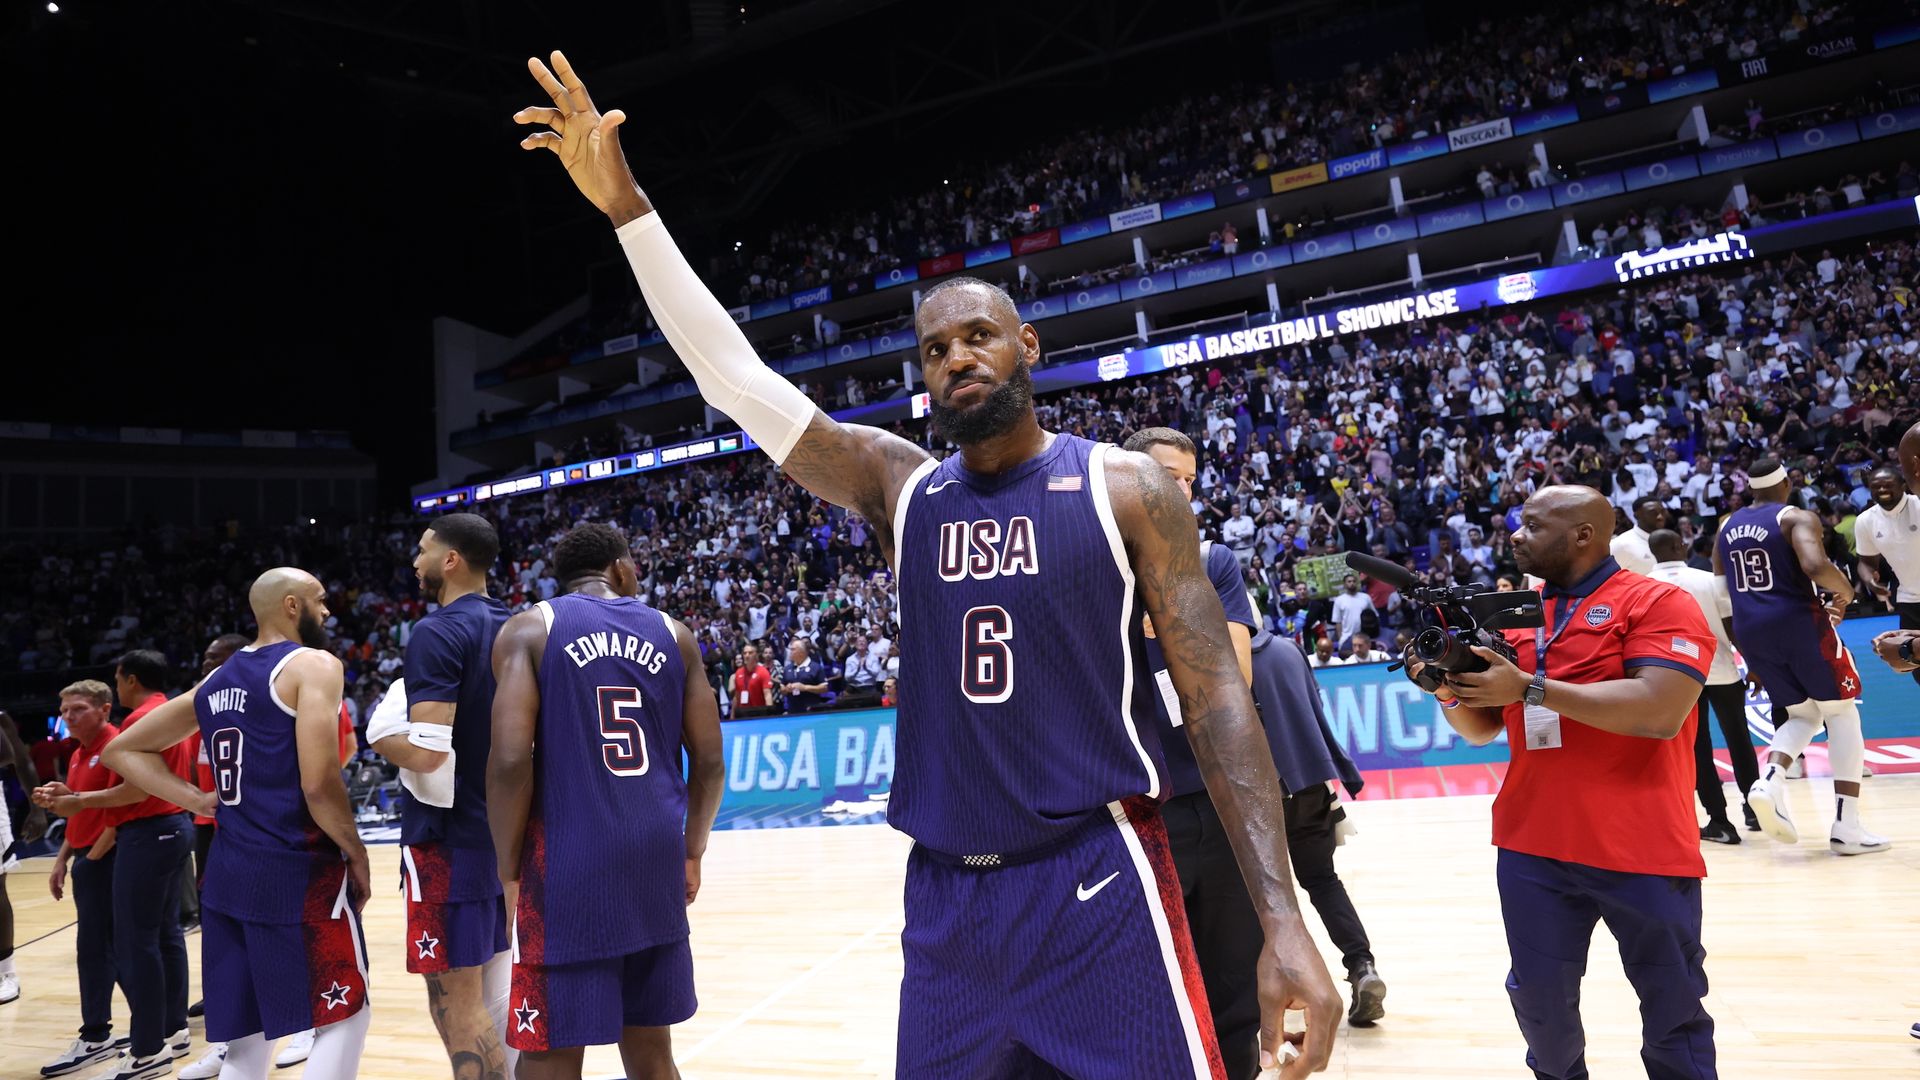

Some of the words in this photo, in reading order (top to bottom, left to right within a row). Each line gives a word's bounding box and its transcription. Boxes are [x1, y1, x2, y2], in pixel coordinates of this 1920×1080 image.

[1807, 36, 1856, 56] QATAR
[1741, 57, 1768, 78] FIAT
[1333, 149, 1381, 178] gopuff
[1116, 208, 1154, 222] AMERICAN
[1122, 214, 1155, 226] EXPRESS
[794, 286, 829, 308] gopuff
[1161, 345, 1202, 367] USA
[1205, 314, 1334, 360] BASKETBALL
[1336, 288, 1460, 335] SHOWCASE
[938, 516, 1040, 583] USA
[1725, 523, 1769, 546] ADEBAYO
[1730, 547, 1774, 593] 13
[563, 631, 668, 675] EDWARDS
[960, 605, 1014, 704] 6
[207, 687, 248, 717] WHITE
[596, 686, 650, 777] 5
[211, 727, 244, 807] 8
[729, 728, 821, 793] USA
[834, 723, 897, 789] BA
